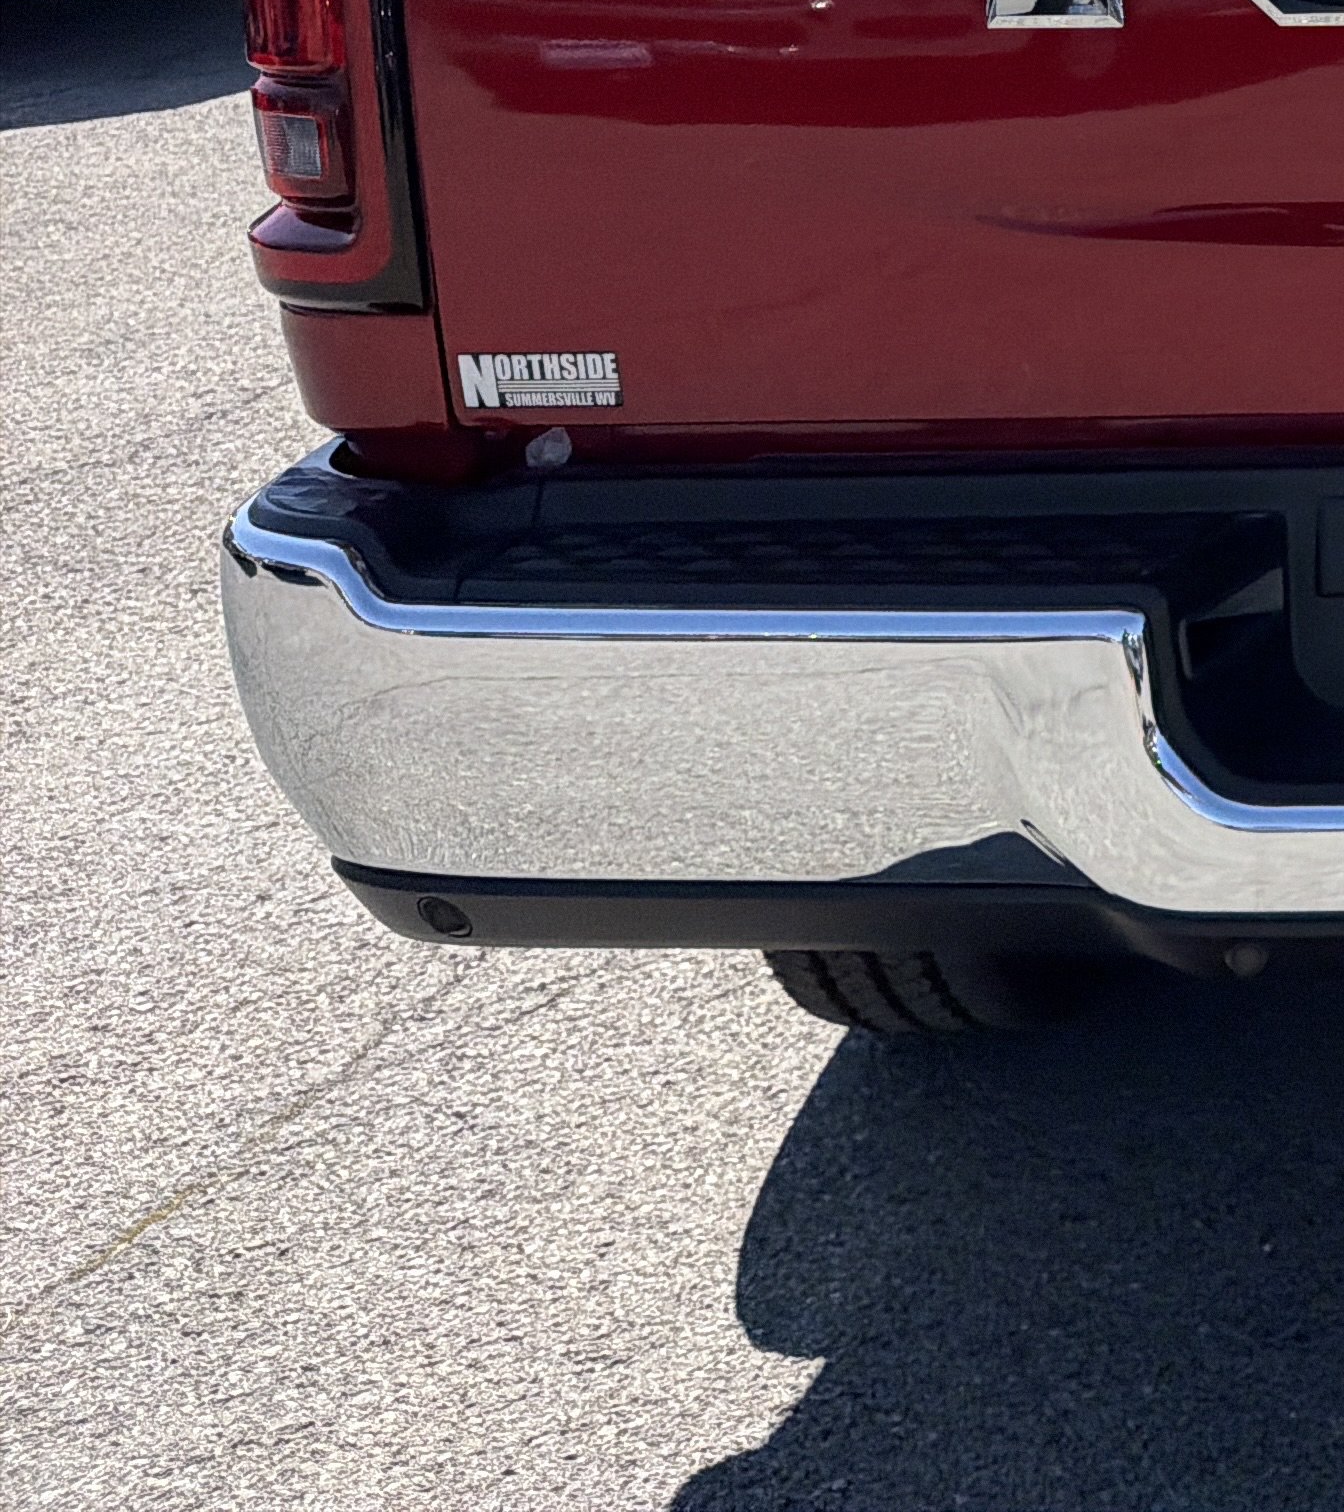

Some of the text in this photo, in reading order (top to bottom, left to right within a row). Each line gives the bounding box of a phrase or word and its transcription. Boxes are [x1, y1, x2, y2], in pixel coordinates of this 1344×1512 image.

[457, 353, 619, 408] NORTHSIDE
[505, 391, 616, 407] SUMMERSVILLE WV
